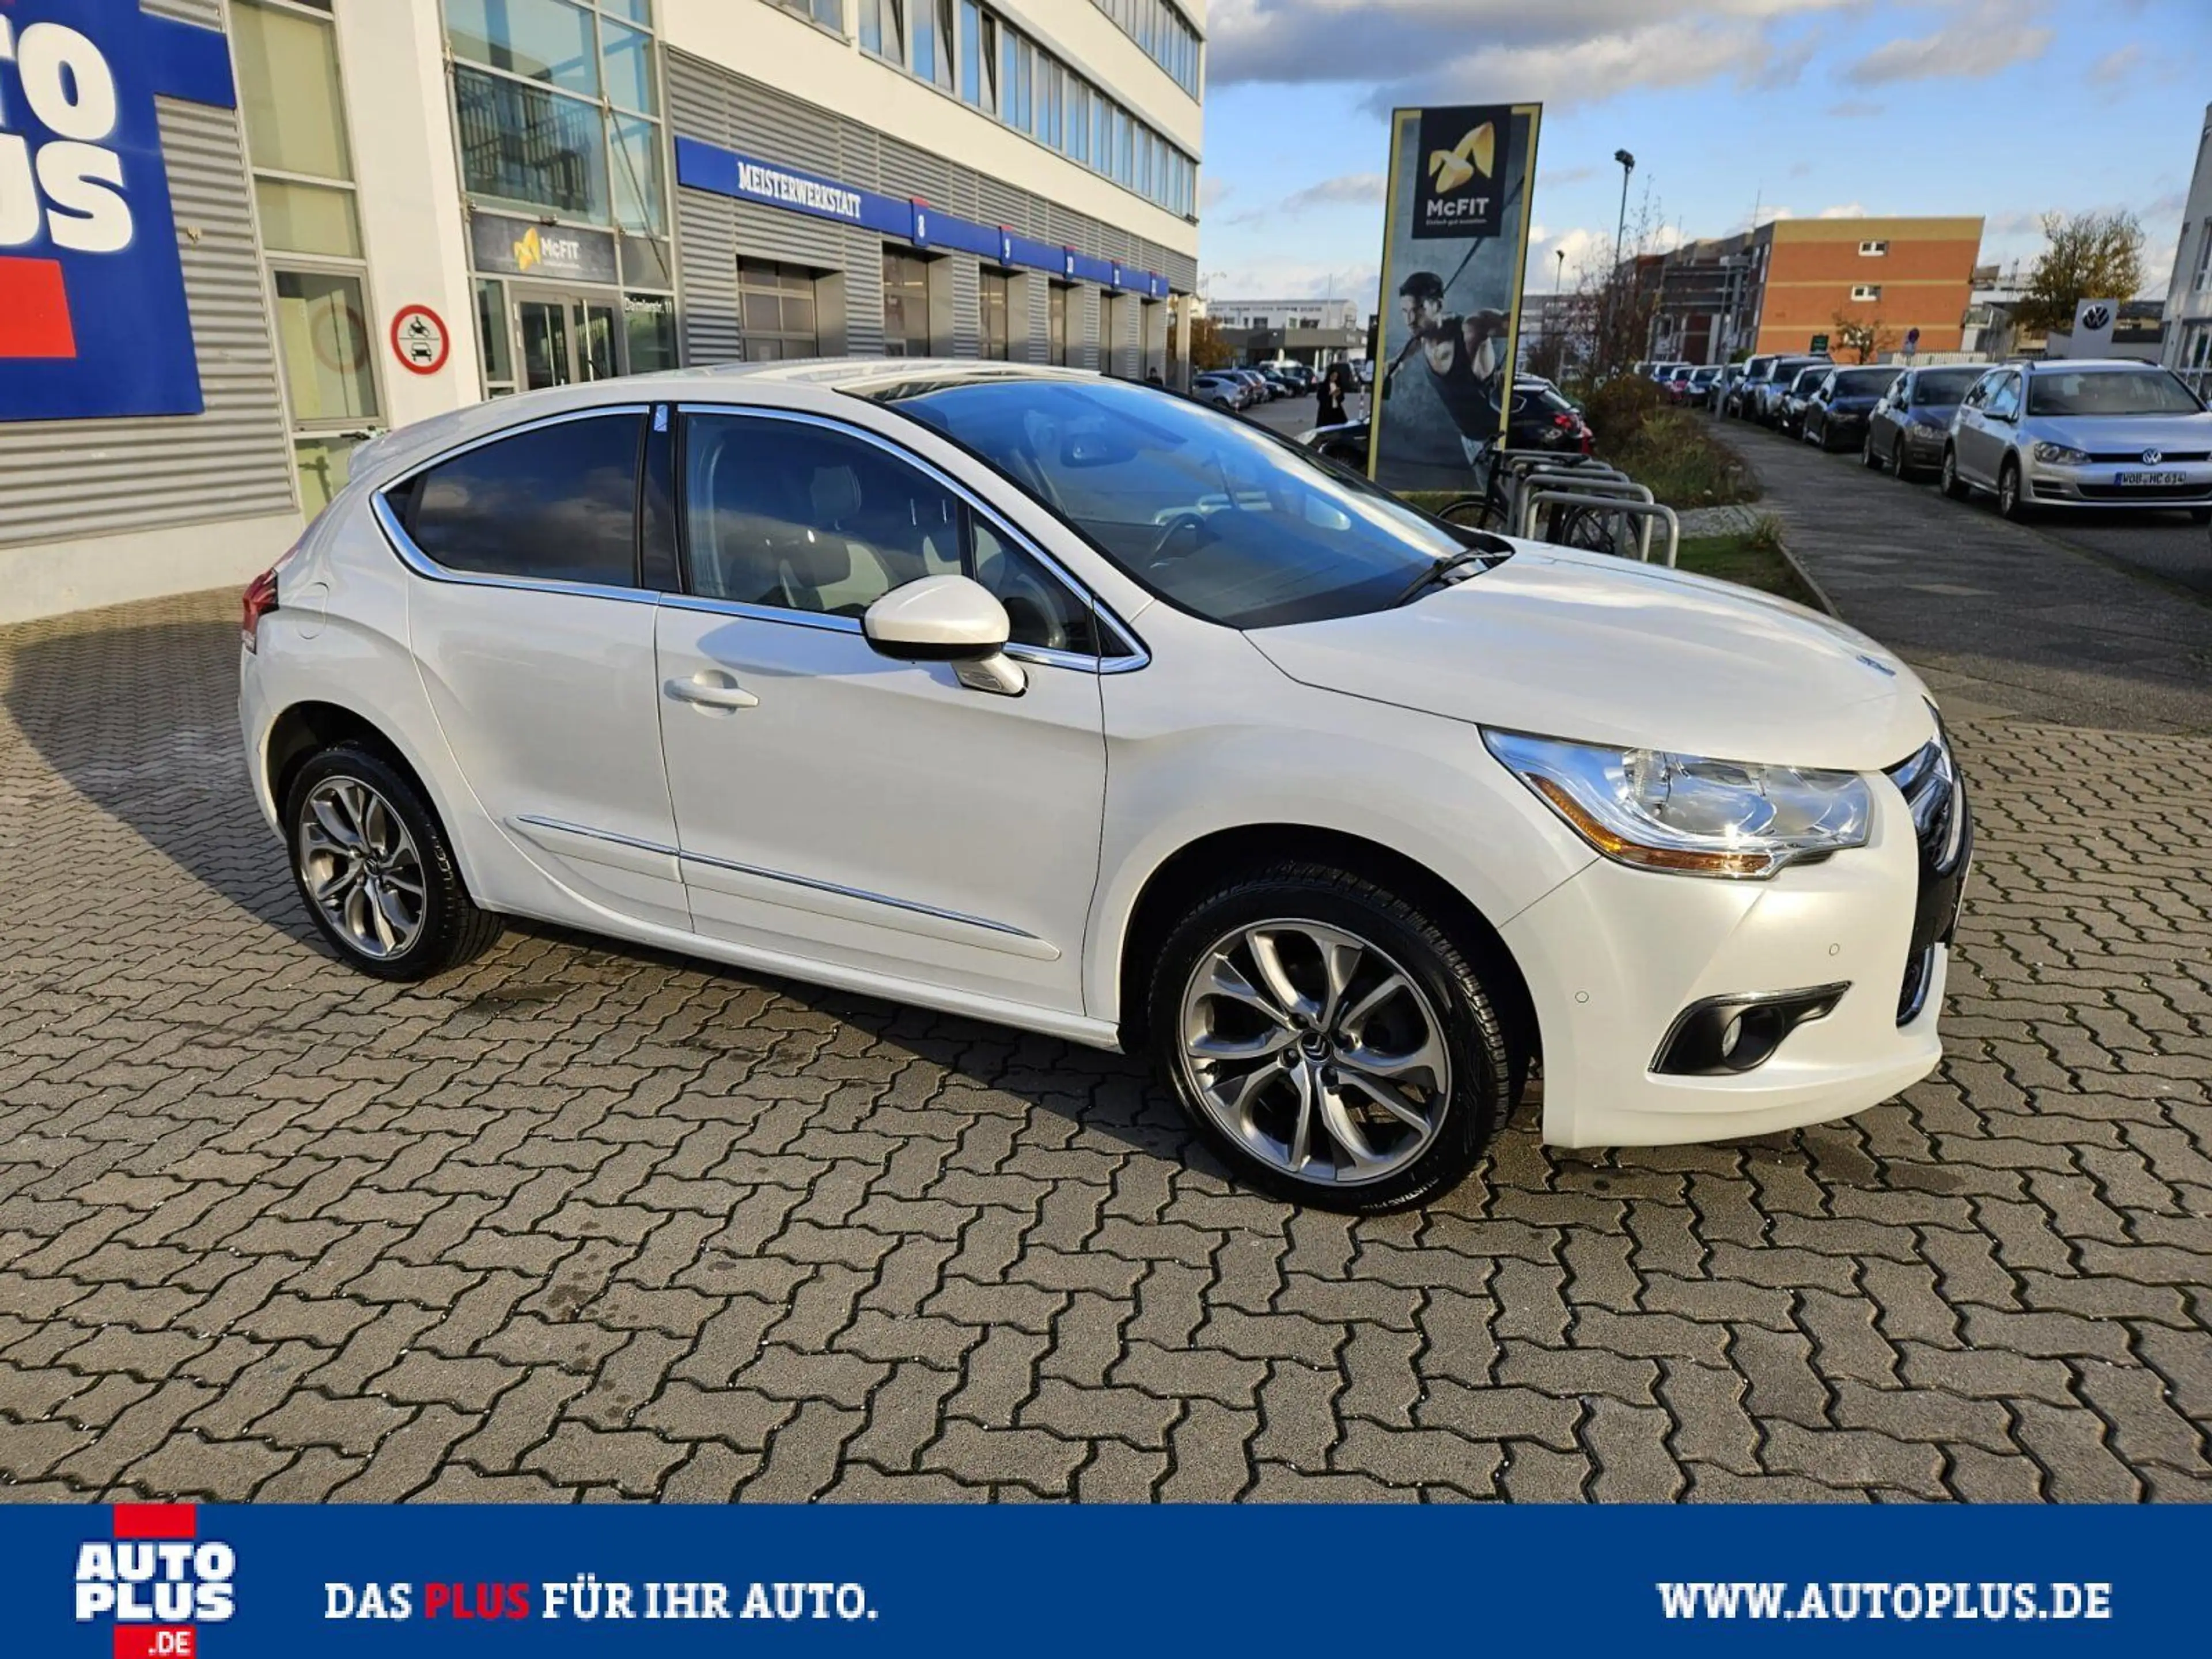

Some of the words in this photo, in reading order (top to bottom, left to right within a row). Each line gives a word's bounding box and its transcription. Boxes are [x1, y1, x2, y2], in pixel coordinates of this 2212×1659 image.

[738, 161, 861, 219] MEISTERWERKSTATT
[1426, 197, 1490, 217] McFIT
[540, 237, 579, 260] McFIT
